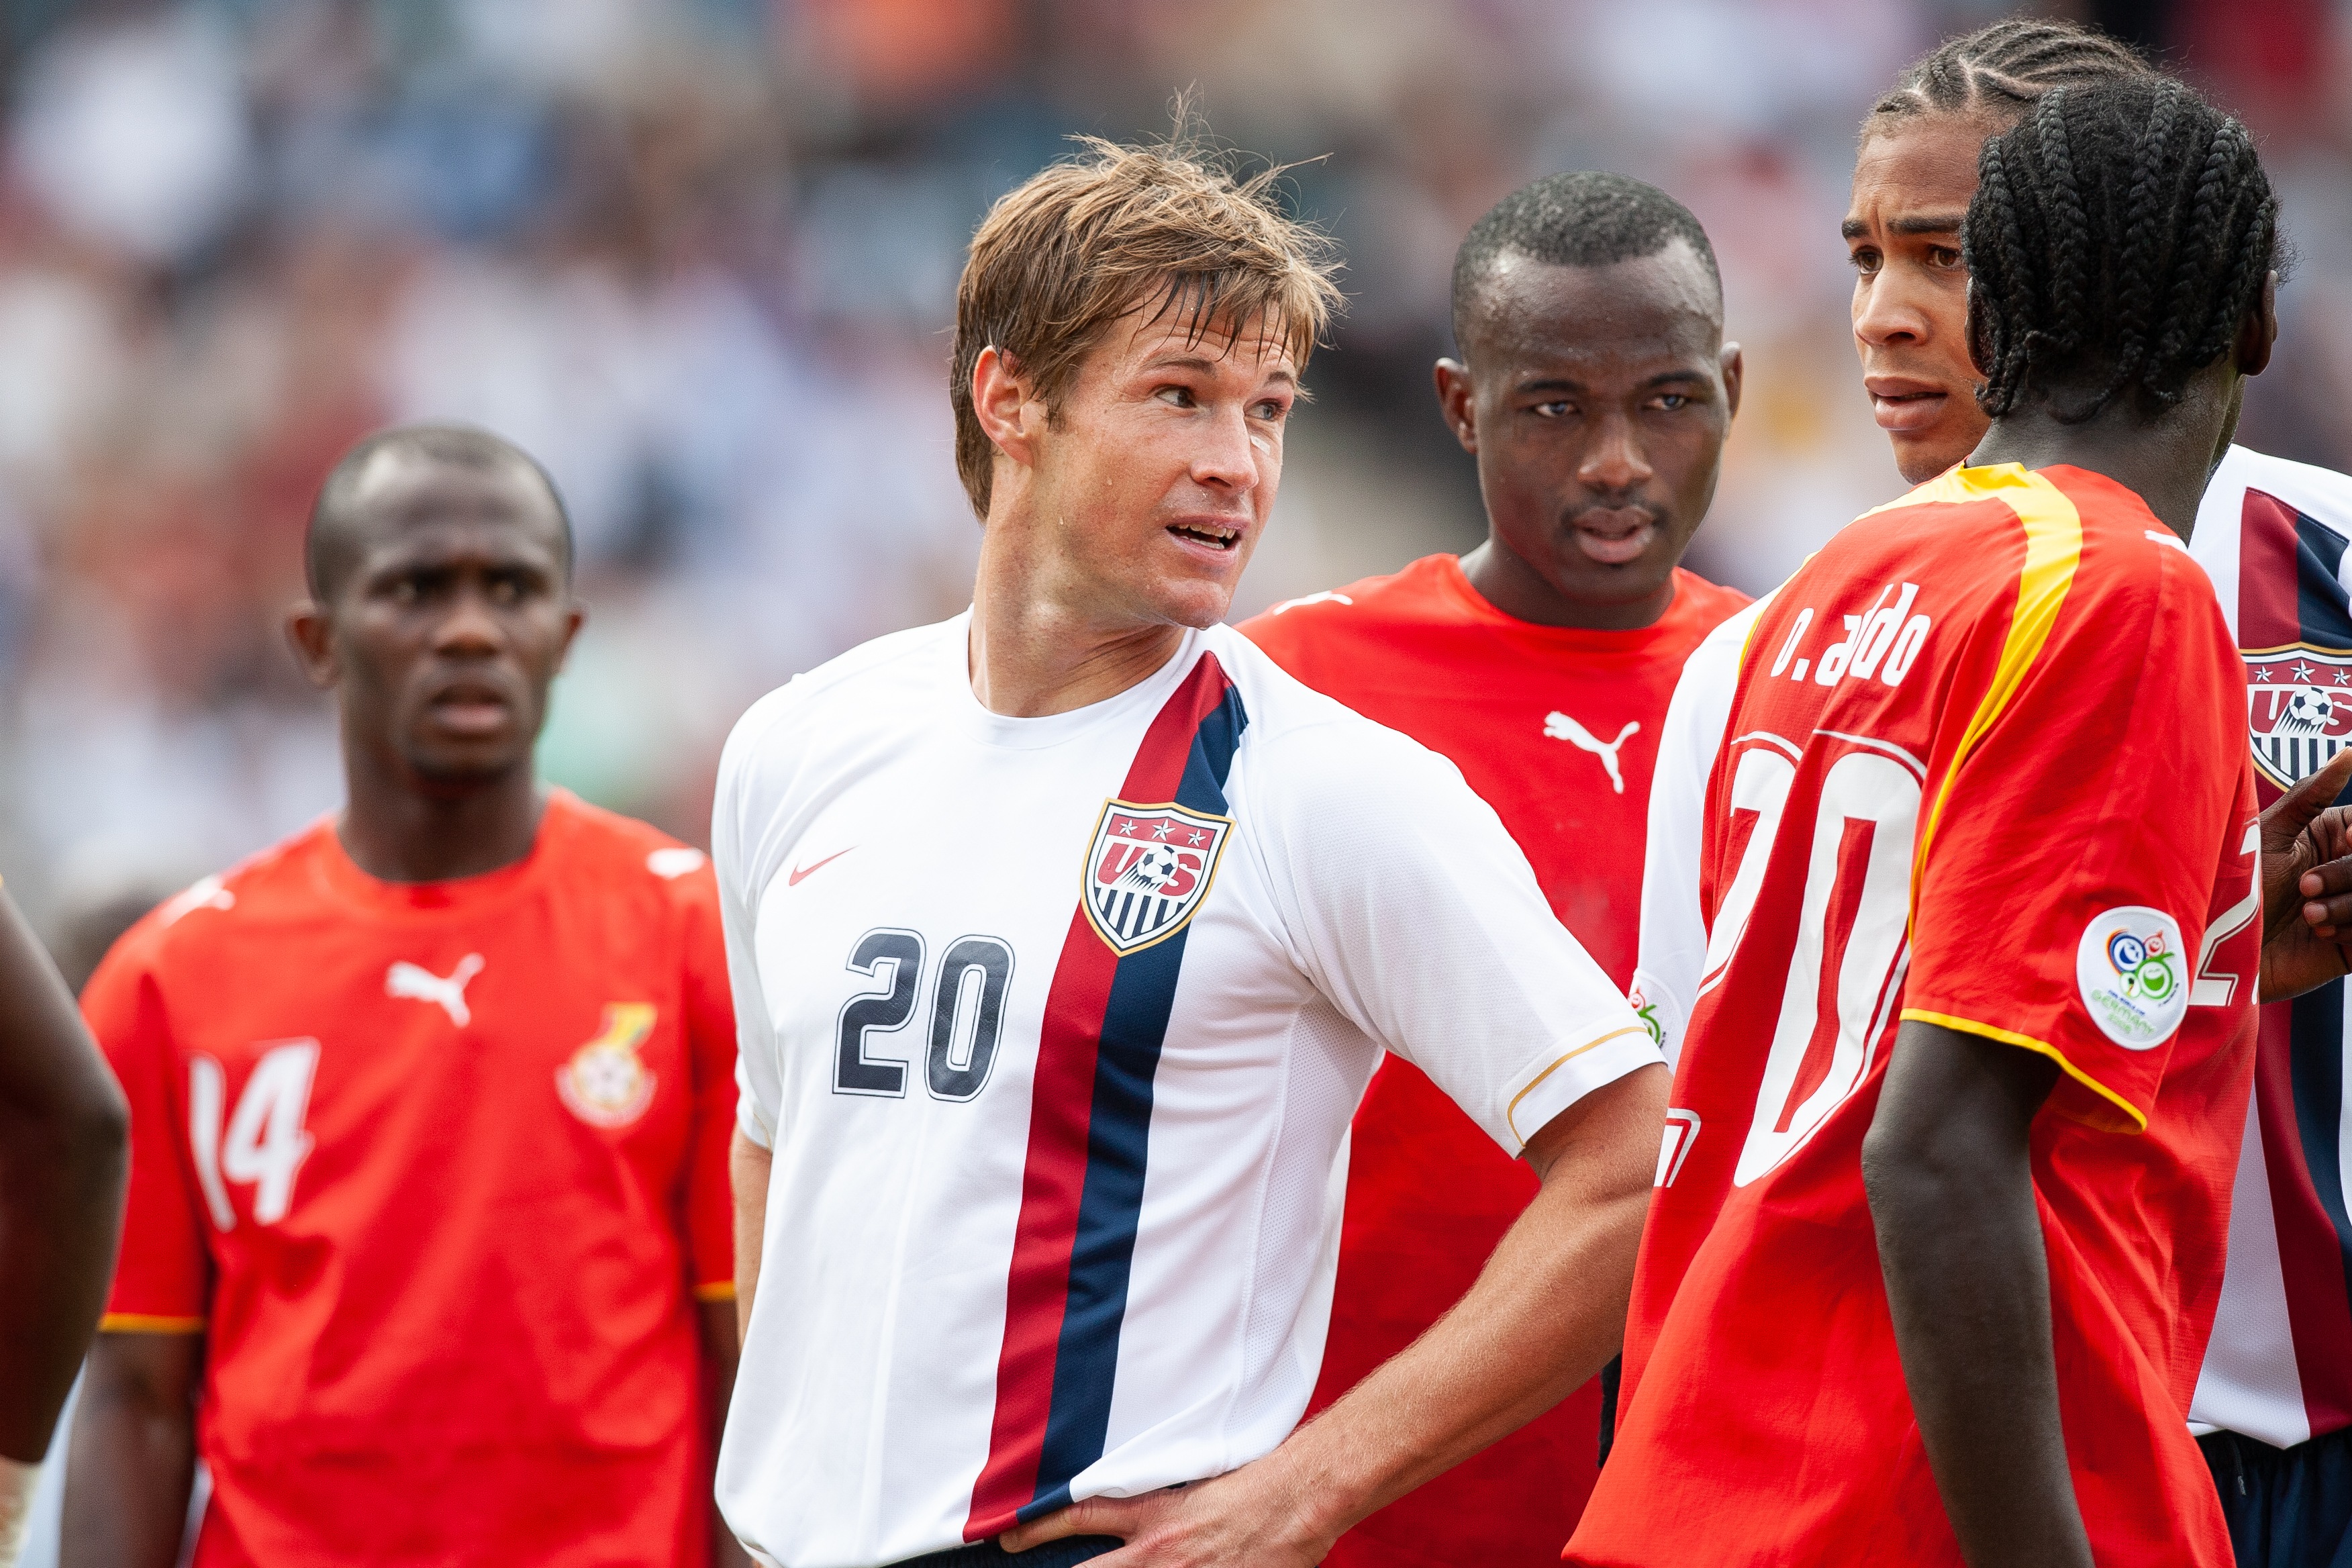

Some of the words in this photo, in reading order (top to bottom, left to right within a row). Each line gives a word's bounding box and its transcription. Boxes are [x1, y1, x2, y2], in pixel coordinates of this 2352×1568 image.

[1097, 842, 1202, 896] US
[832, 927, 1015, 1103] 20
[188, 1037, 320, 1232] 14
